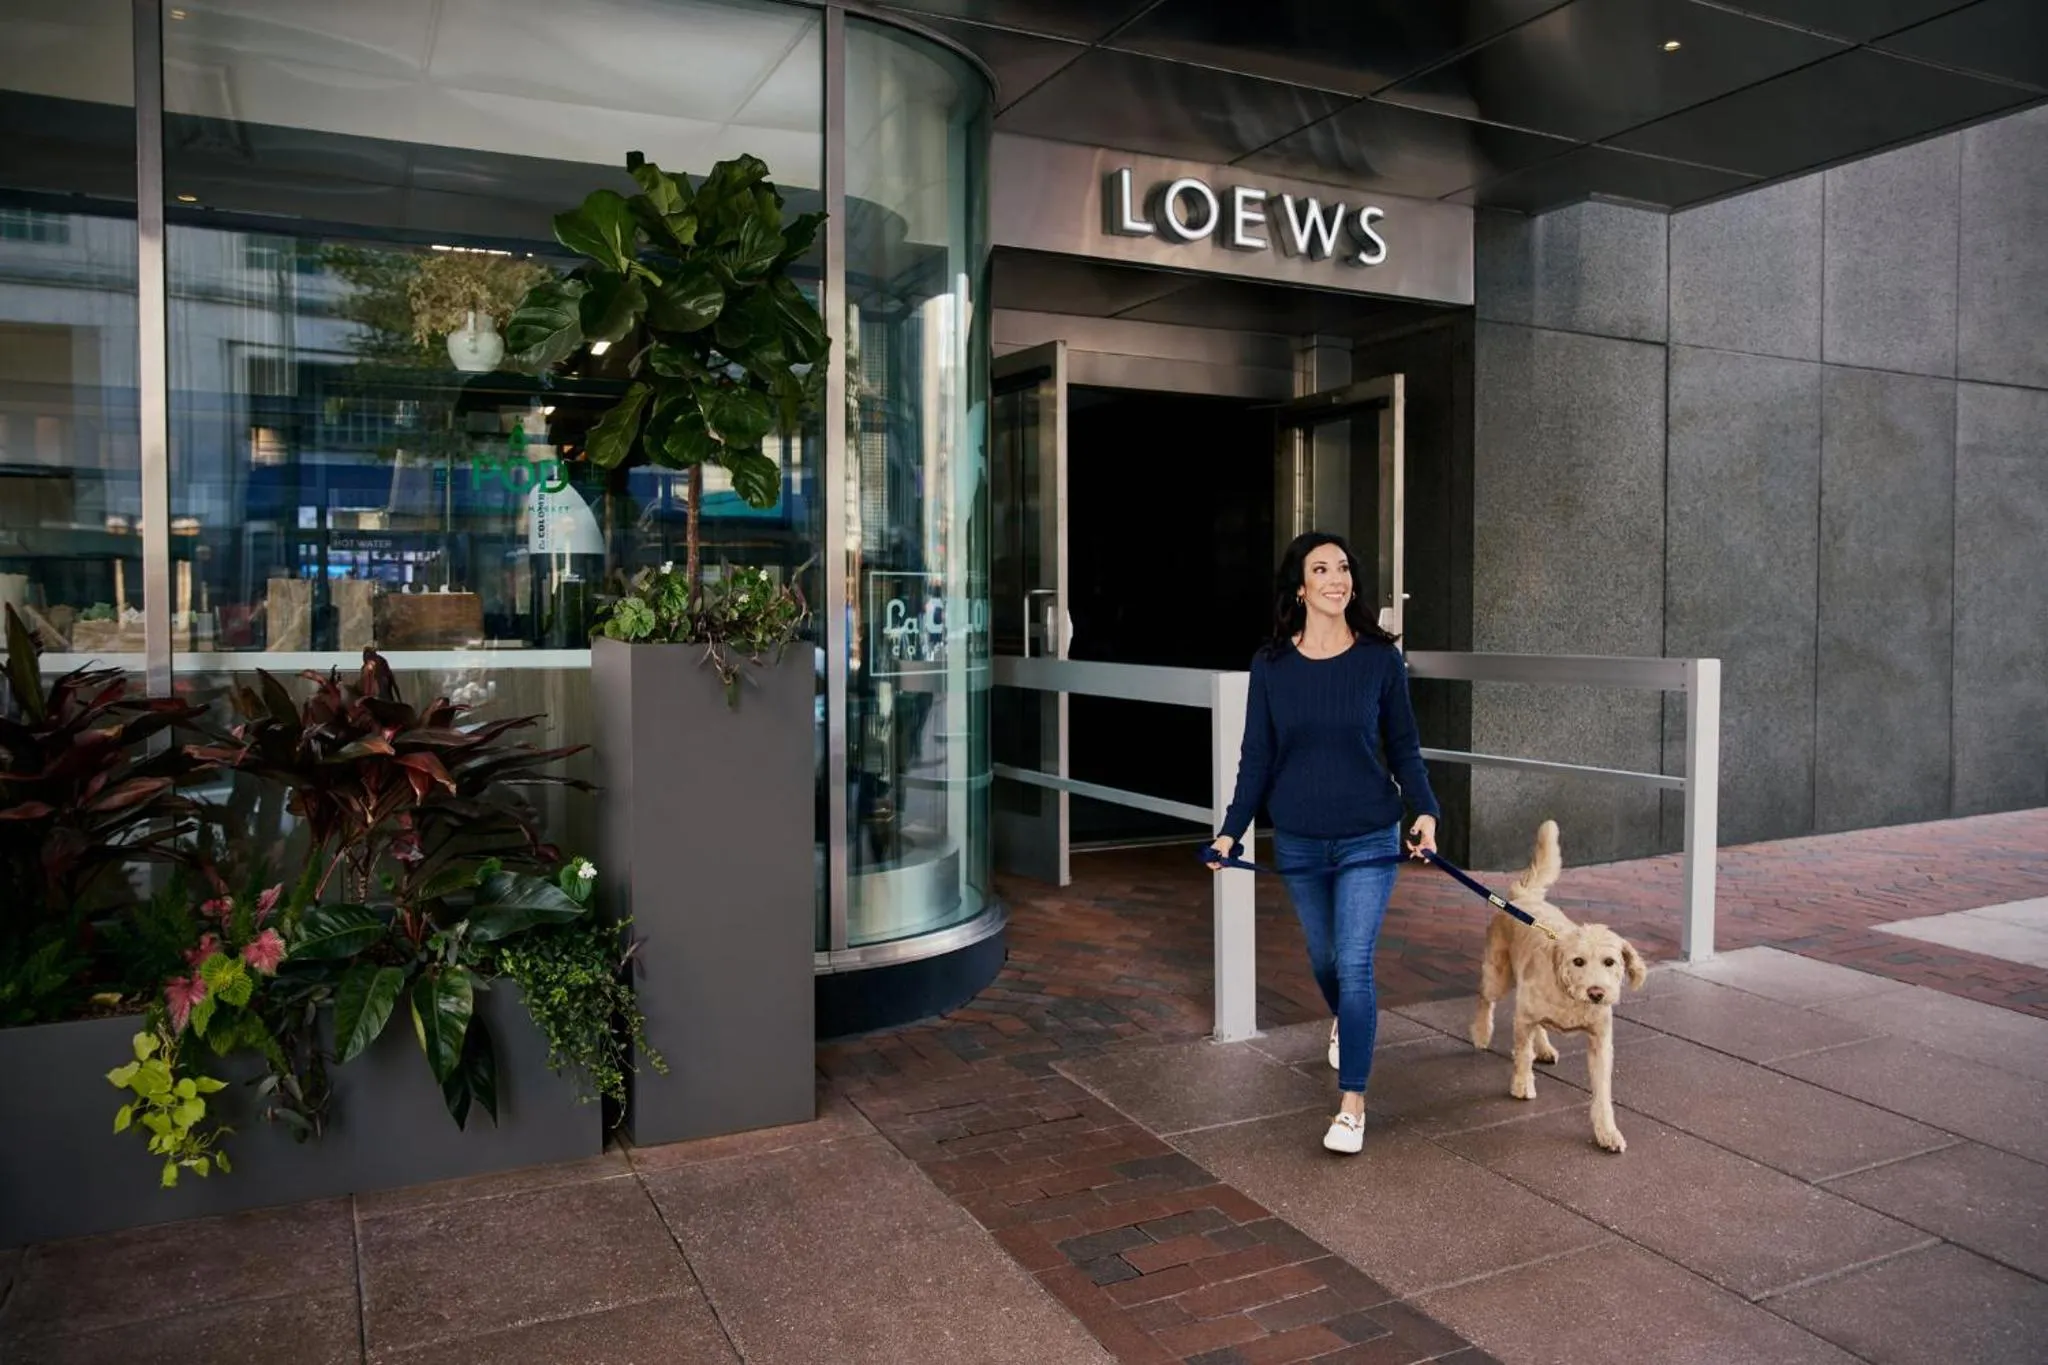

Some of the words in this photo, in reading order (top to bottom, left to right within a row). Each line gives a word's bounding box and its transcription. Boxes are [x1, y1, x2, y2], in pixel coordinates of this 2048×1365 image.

[1113, 167, 1387, 265] LOEWS
[472, 456, 568, 493] POD
[333, 539, 354, 549] HOT
[357, 539, 392, 549] WATER
[883, 599, 919, 634] La
